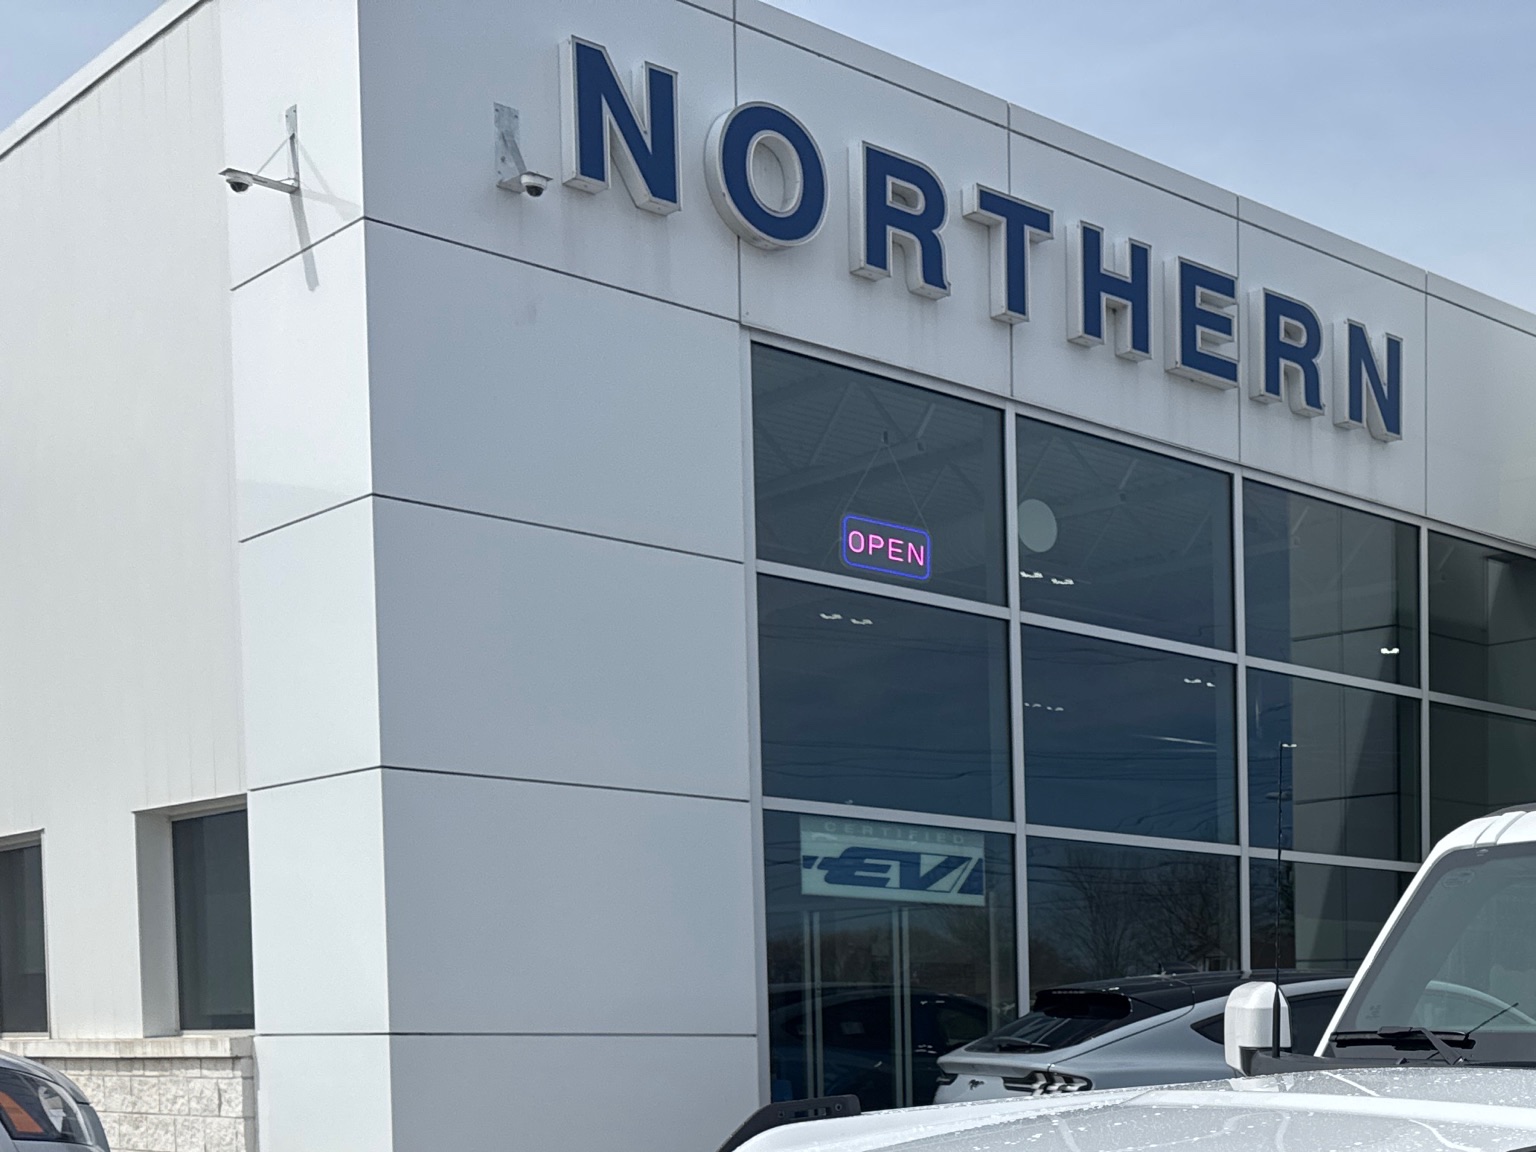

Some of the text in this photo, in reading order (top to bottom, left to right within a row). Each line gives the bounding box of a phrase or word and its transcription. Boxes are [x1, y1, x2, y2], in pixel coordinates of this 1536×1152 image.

[562, 35, 1403, 442] NORTHERN
[848, 530, 924, 567] OPEN
[824, 821, 964, 844] CERTIFIED
[818, 846, 974, 893] EV
